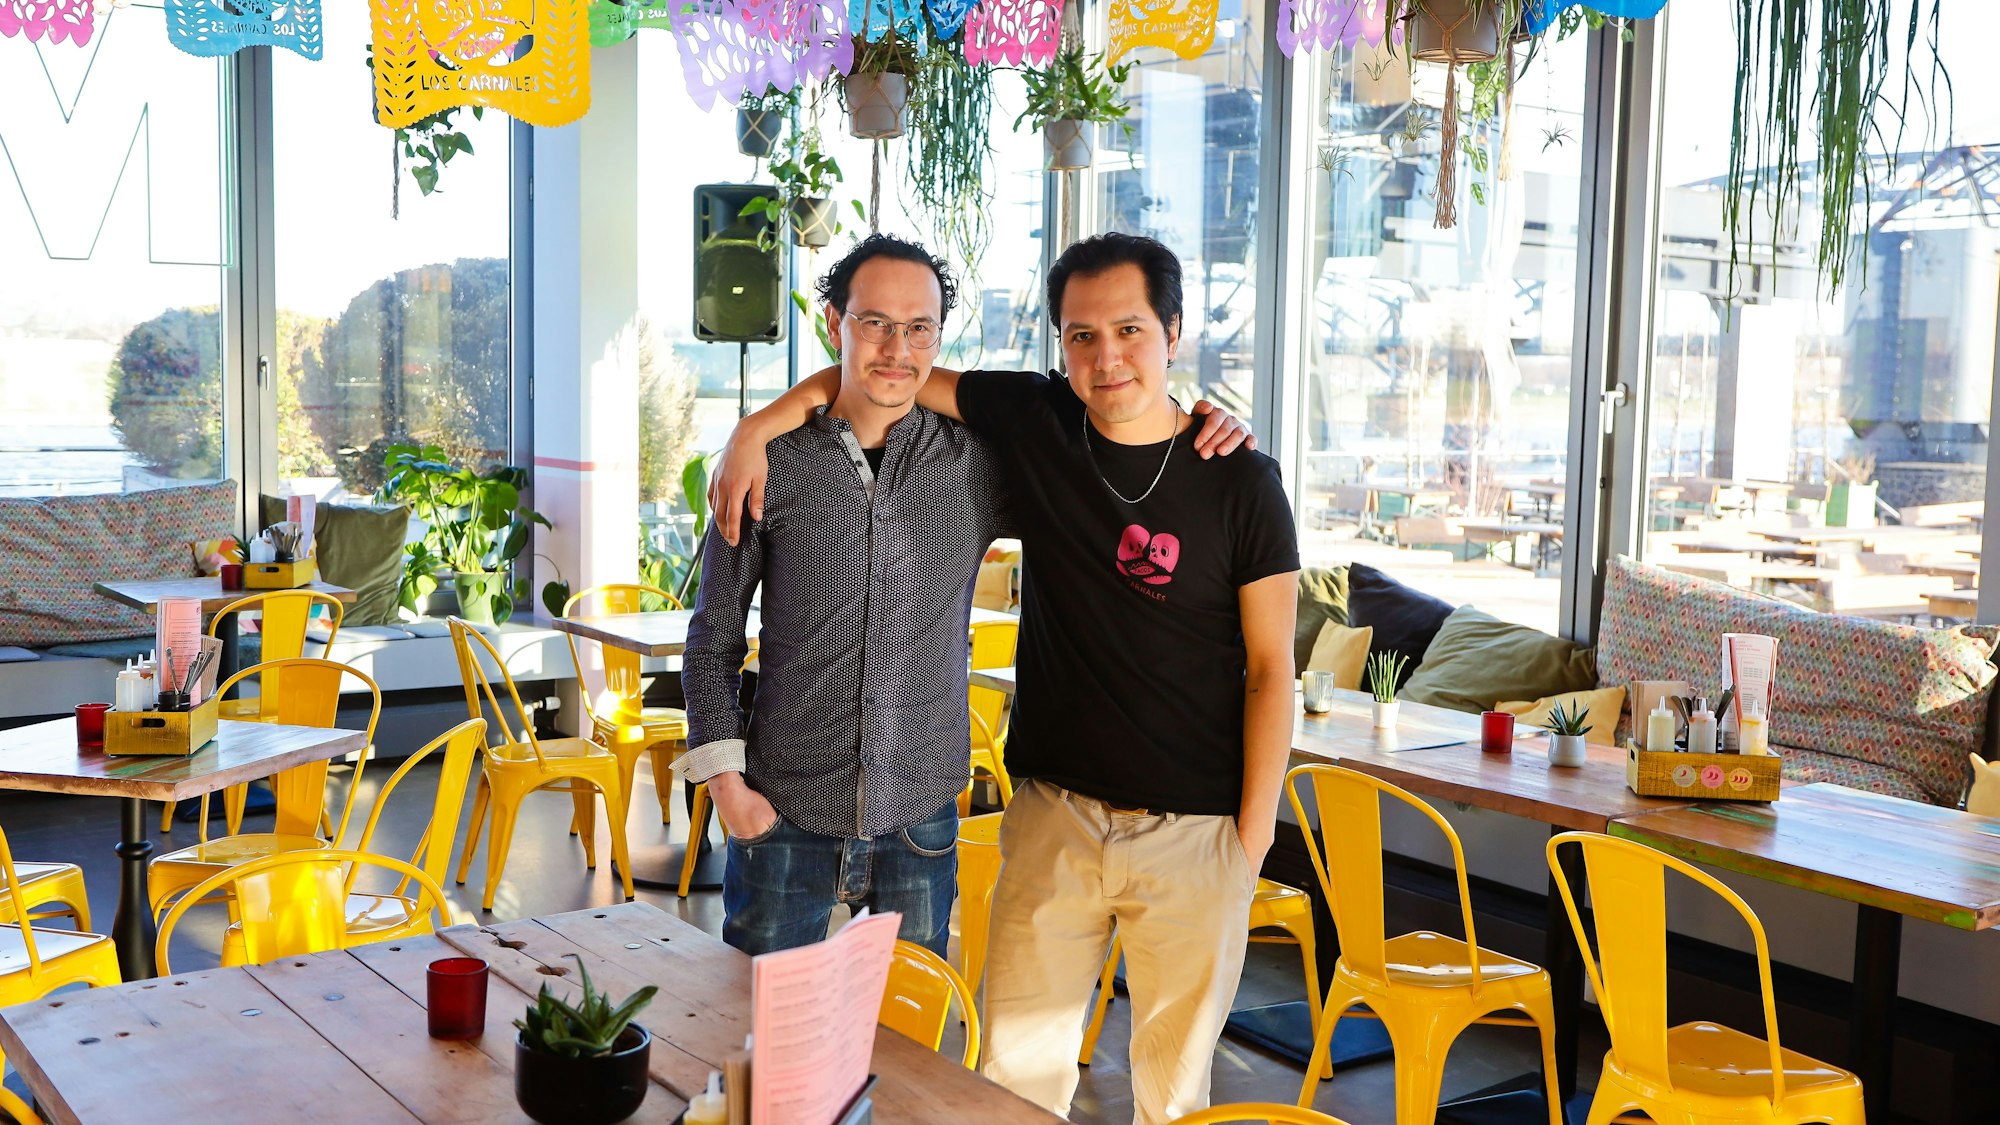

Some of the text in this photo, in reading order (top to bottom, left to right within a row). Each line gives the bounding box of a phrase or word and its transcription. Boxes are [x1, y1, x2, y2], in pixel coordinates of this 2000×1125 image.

[421, 74, 540, 92] LOS CARNALES
[1129, 580, 1167, 602] ARNALES
